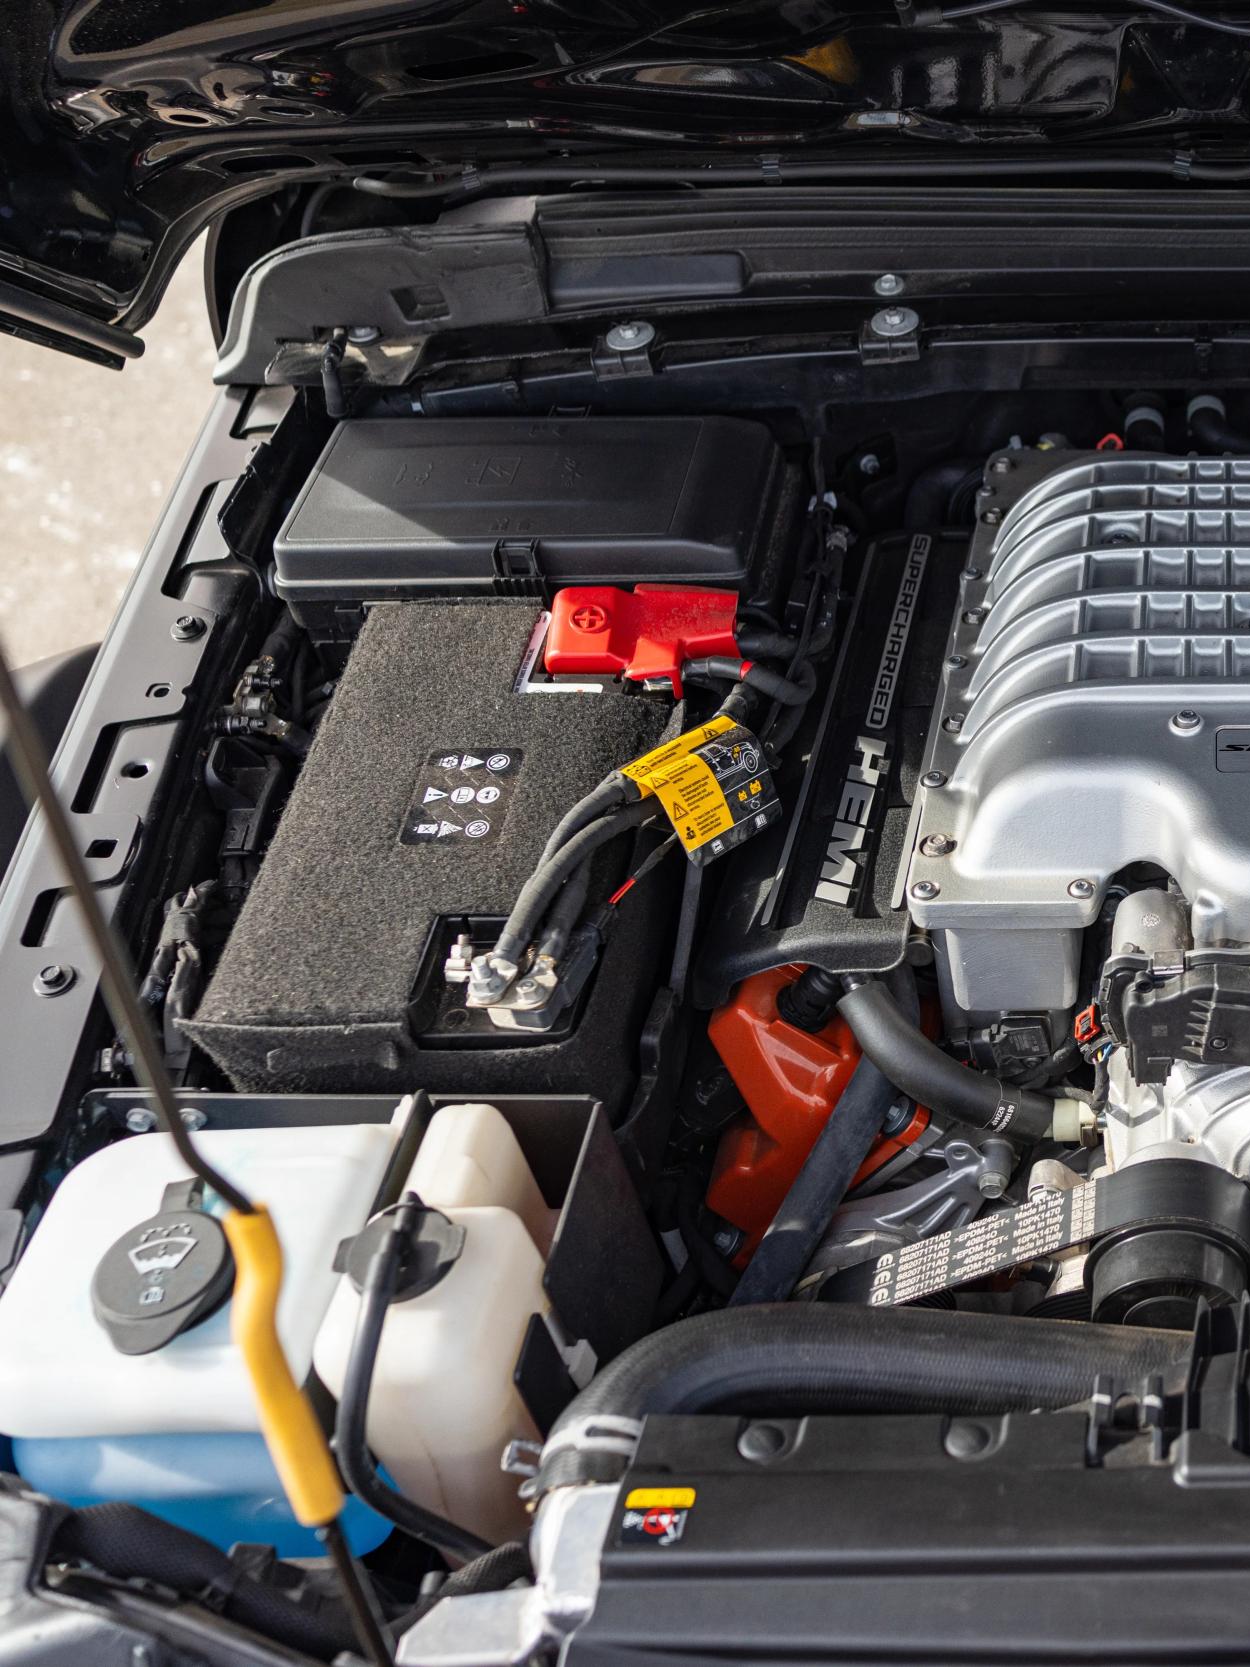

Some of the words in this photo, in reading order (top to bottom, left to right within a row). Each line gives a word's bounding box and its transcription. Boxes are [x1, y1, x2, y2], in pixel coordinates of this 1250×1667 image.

[869, 535, 930, 726] SUPERCHARGED
[814, 735, 887, 905] HEMI
[1014, 1206, 1037, 1220] Made
[1047, 1197, 1065, 1211] Italy
[1018, 1207, 1061, 1228] 10PK1470
[1013, 1224, 1035, 1238] Made
[1045, 1214, 1064, 1228] Italy
[1016, 1224, 1060, 1245] 10PK1470
[1011, 1241, 1034, 1255] Made
[1044, 1231, 1063, 1245] Italy
